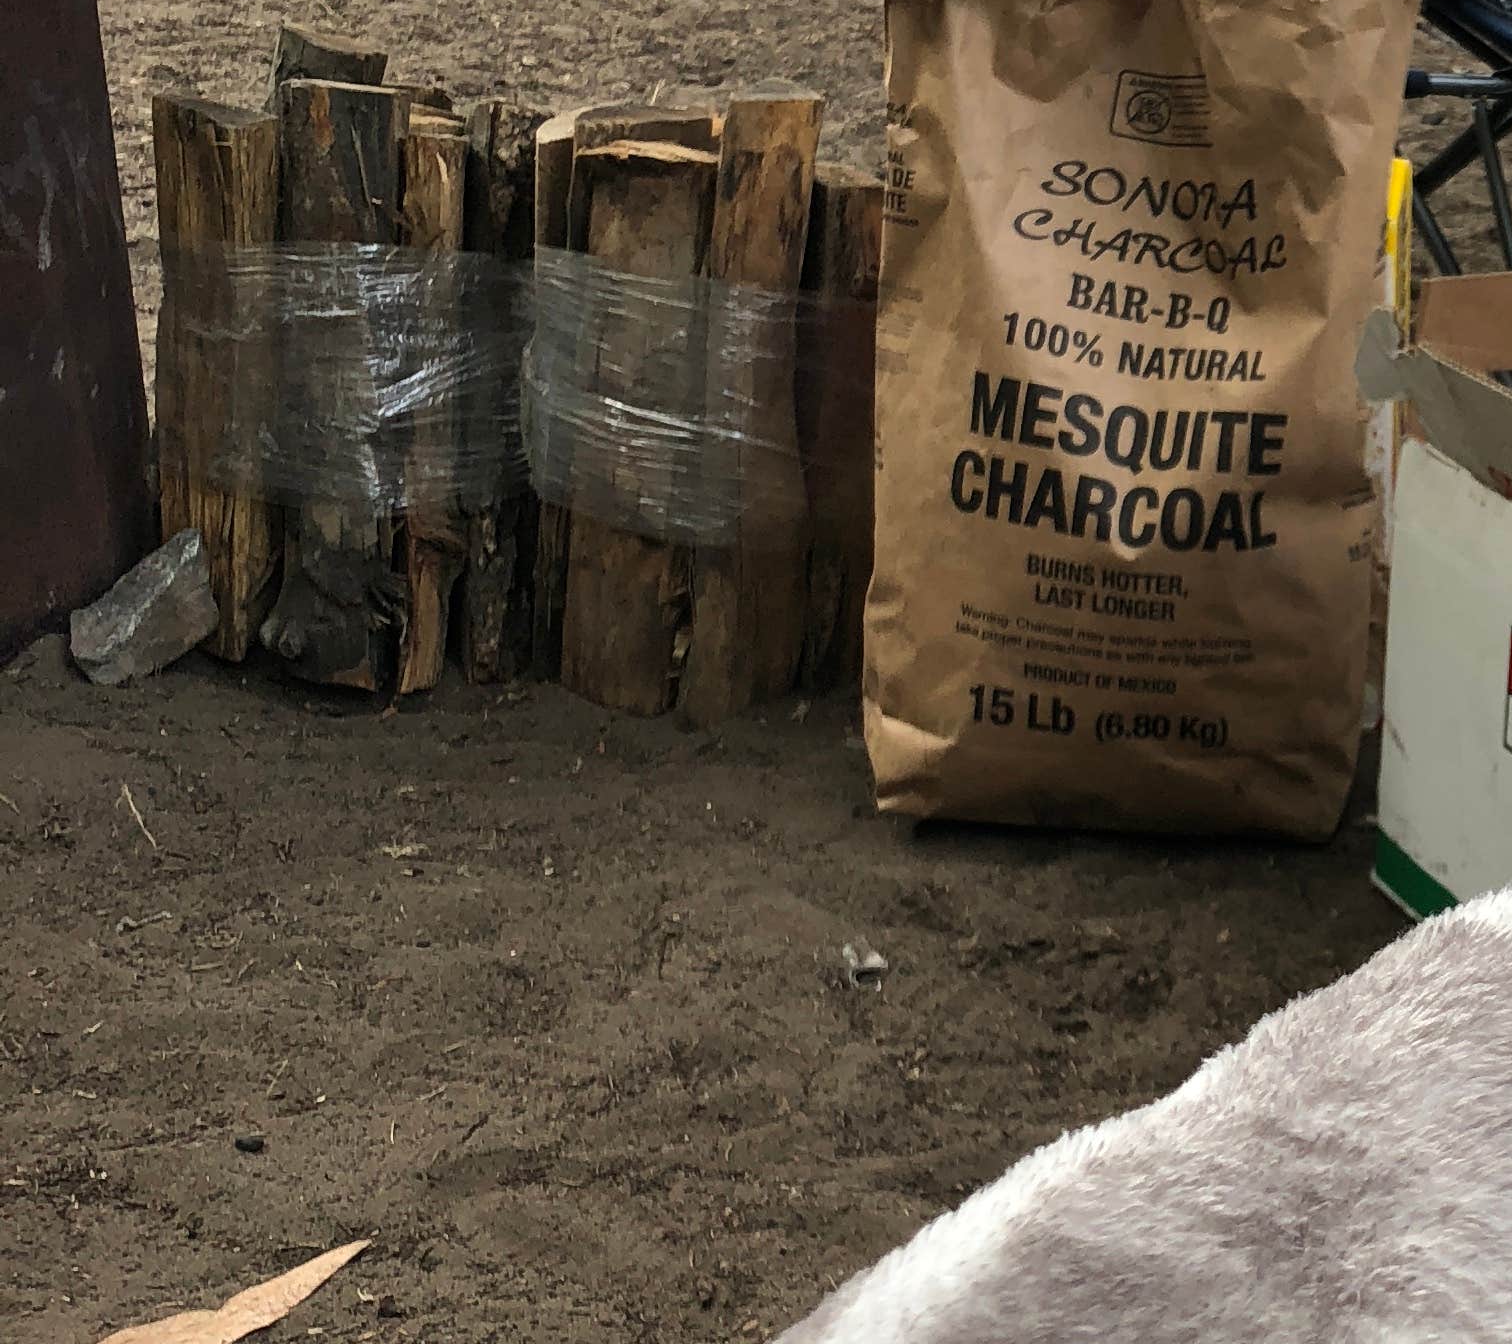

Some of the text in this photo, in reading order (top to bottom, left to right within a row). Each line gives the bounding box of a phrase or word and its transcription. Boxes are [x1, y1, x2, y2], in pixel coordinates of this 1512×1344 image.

[1013, 208, 1287, 280] CHARCOAL
[1067, 272, 1232, 334] BAR-B-Q
[1004, 312, 1266, 381] 100% NATURAL
[970, 370, 1288, 476] MESQUITE
[951, 449, 1277, 552] CHARCOAL
[1027, 553, 1188, 600] BURNS HOTTER,
[1034, 581, 1175, 622] LAST LONGER
[1023, 662, 1176, 695] PRODUCT OF MEXICO
[970, 683, 1230, 748] 15 Lb (6.80 Kg)
